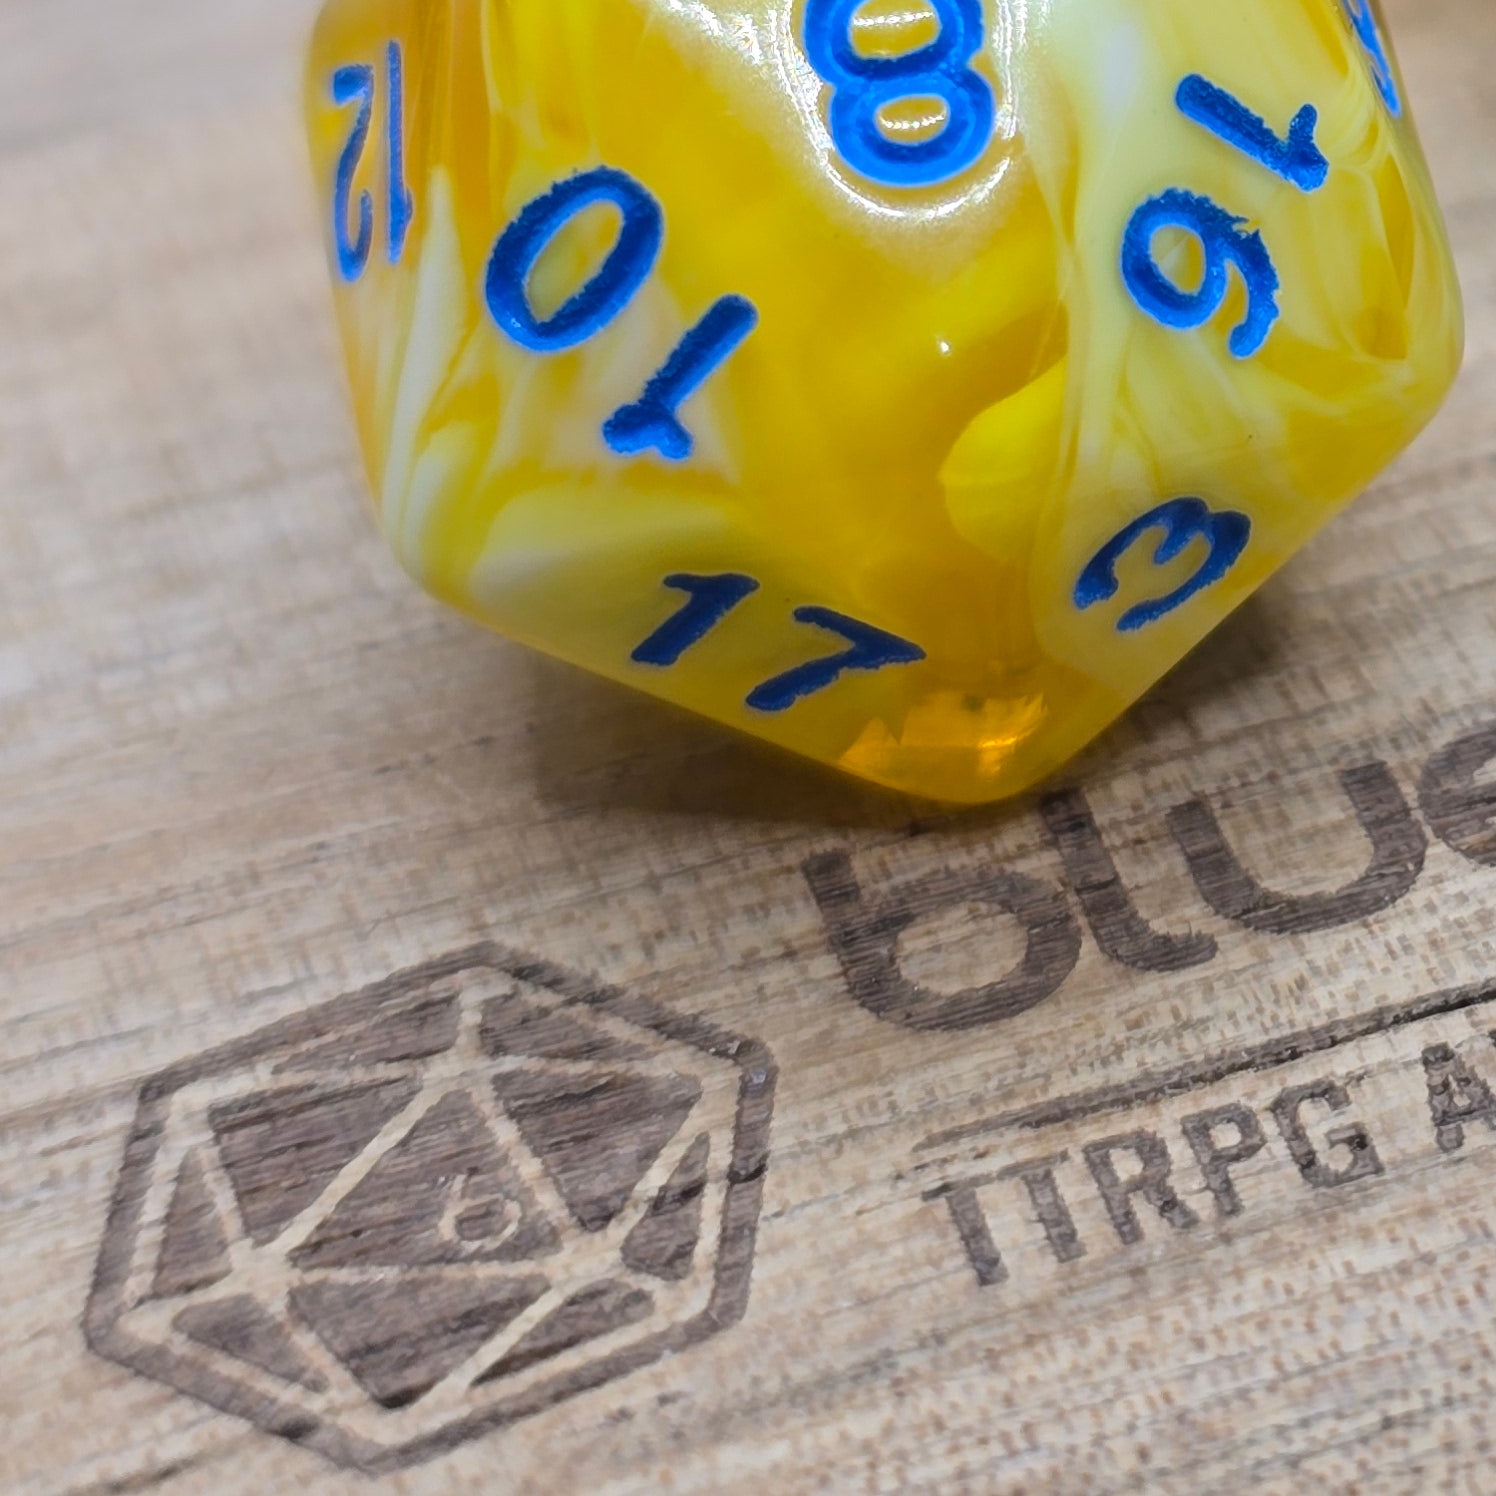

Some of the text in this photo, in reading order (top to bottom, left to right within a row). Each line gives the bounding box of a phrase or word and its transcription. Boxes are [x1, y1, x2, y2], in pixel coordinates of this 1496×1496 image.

[484, 166, 757, 463] 10
[1118, 73, 1330, 359] 16
[631, 571, 928, 713] 17
[1073, 497, 1253, 632] 3
[920, 1077, 1386, 1288] TTRPG
